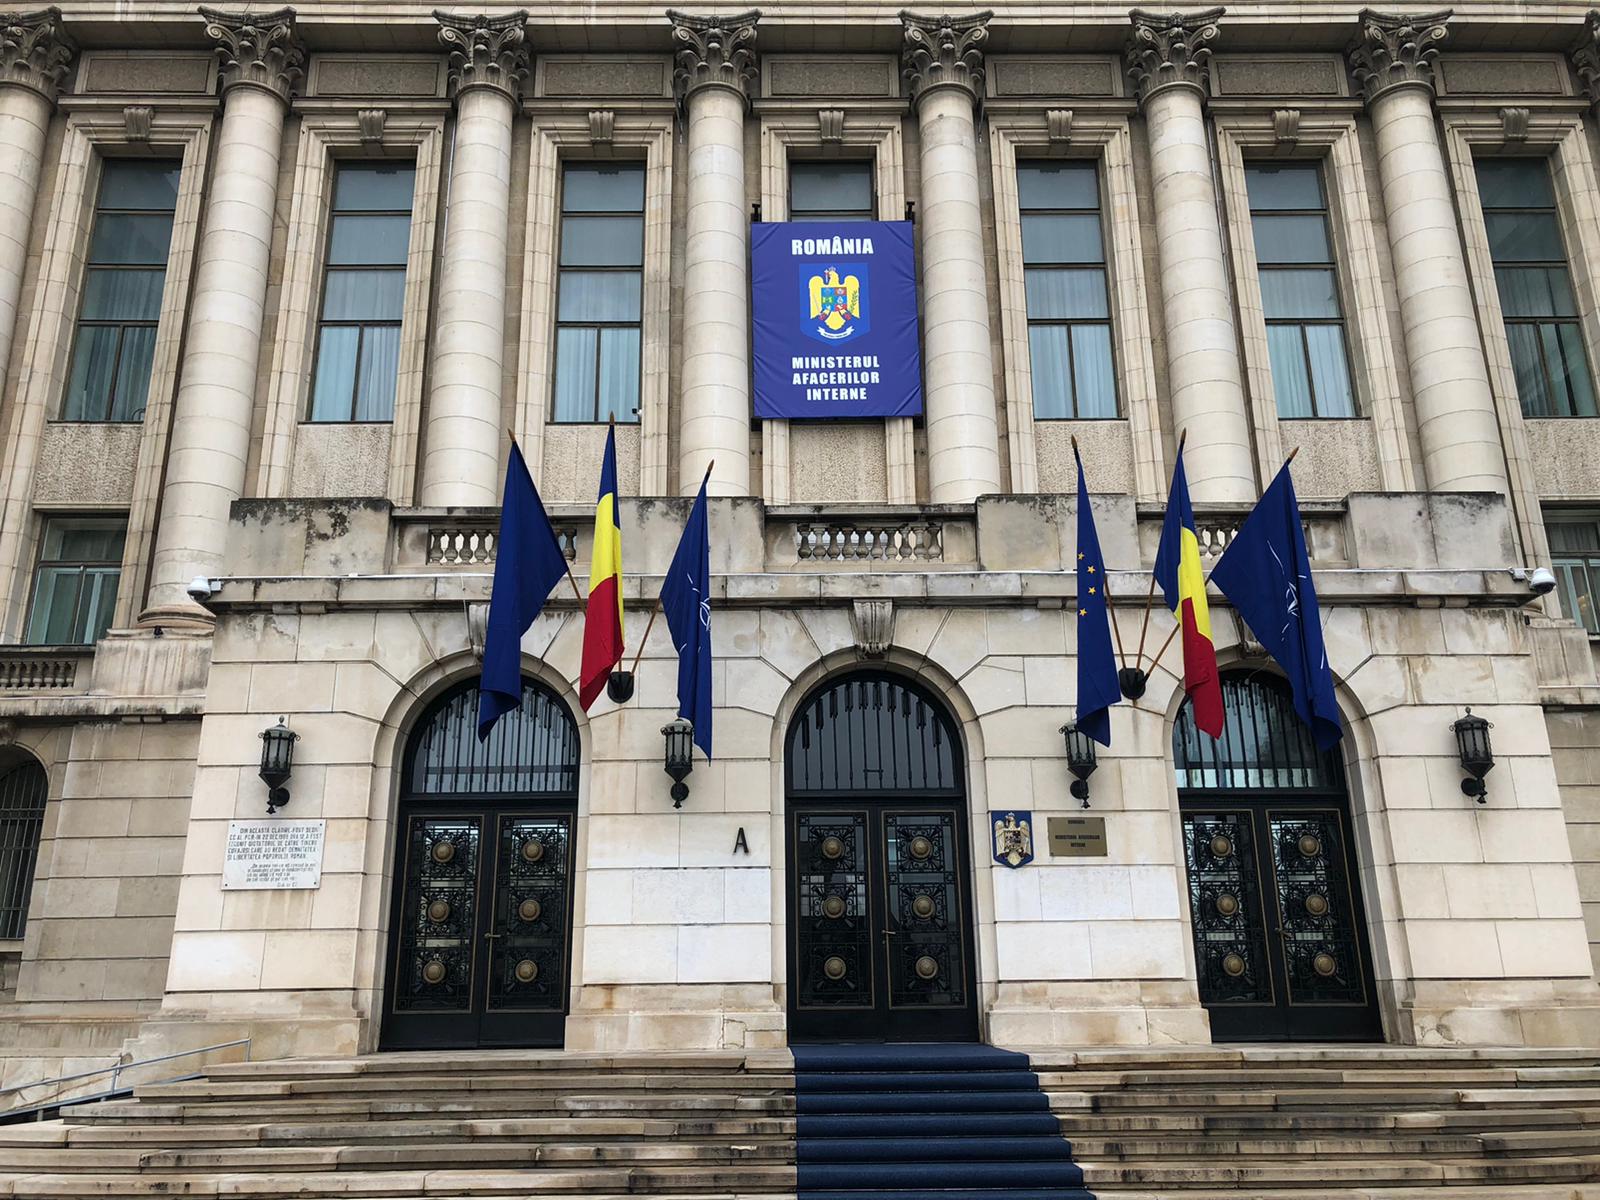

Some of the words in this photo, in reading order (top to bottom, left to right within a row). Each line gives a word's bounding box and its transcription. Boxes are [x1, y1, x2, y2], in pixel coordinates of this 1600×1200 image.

[791, 236, 874, 255] ROMÂNIA
[791, 356, 880, 369] MINISTERUL
[792, 371, 880, 385] AFACERILOR
[806, 388, 867, 401] INTERNE
[733, 827, 749, 854] A
